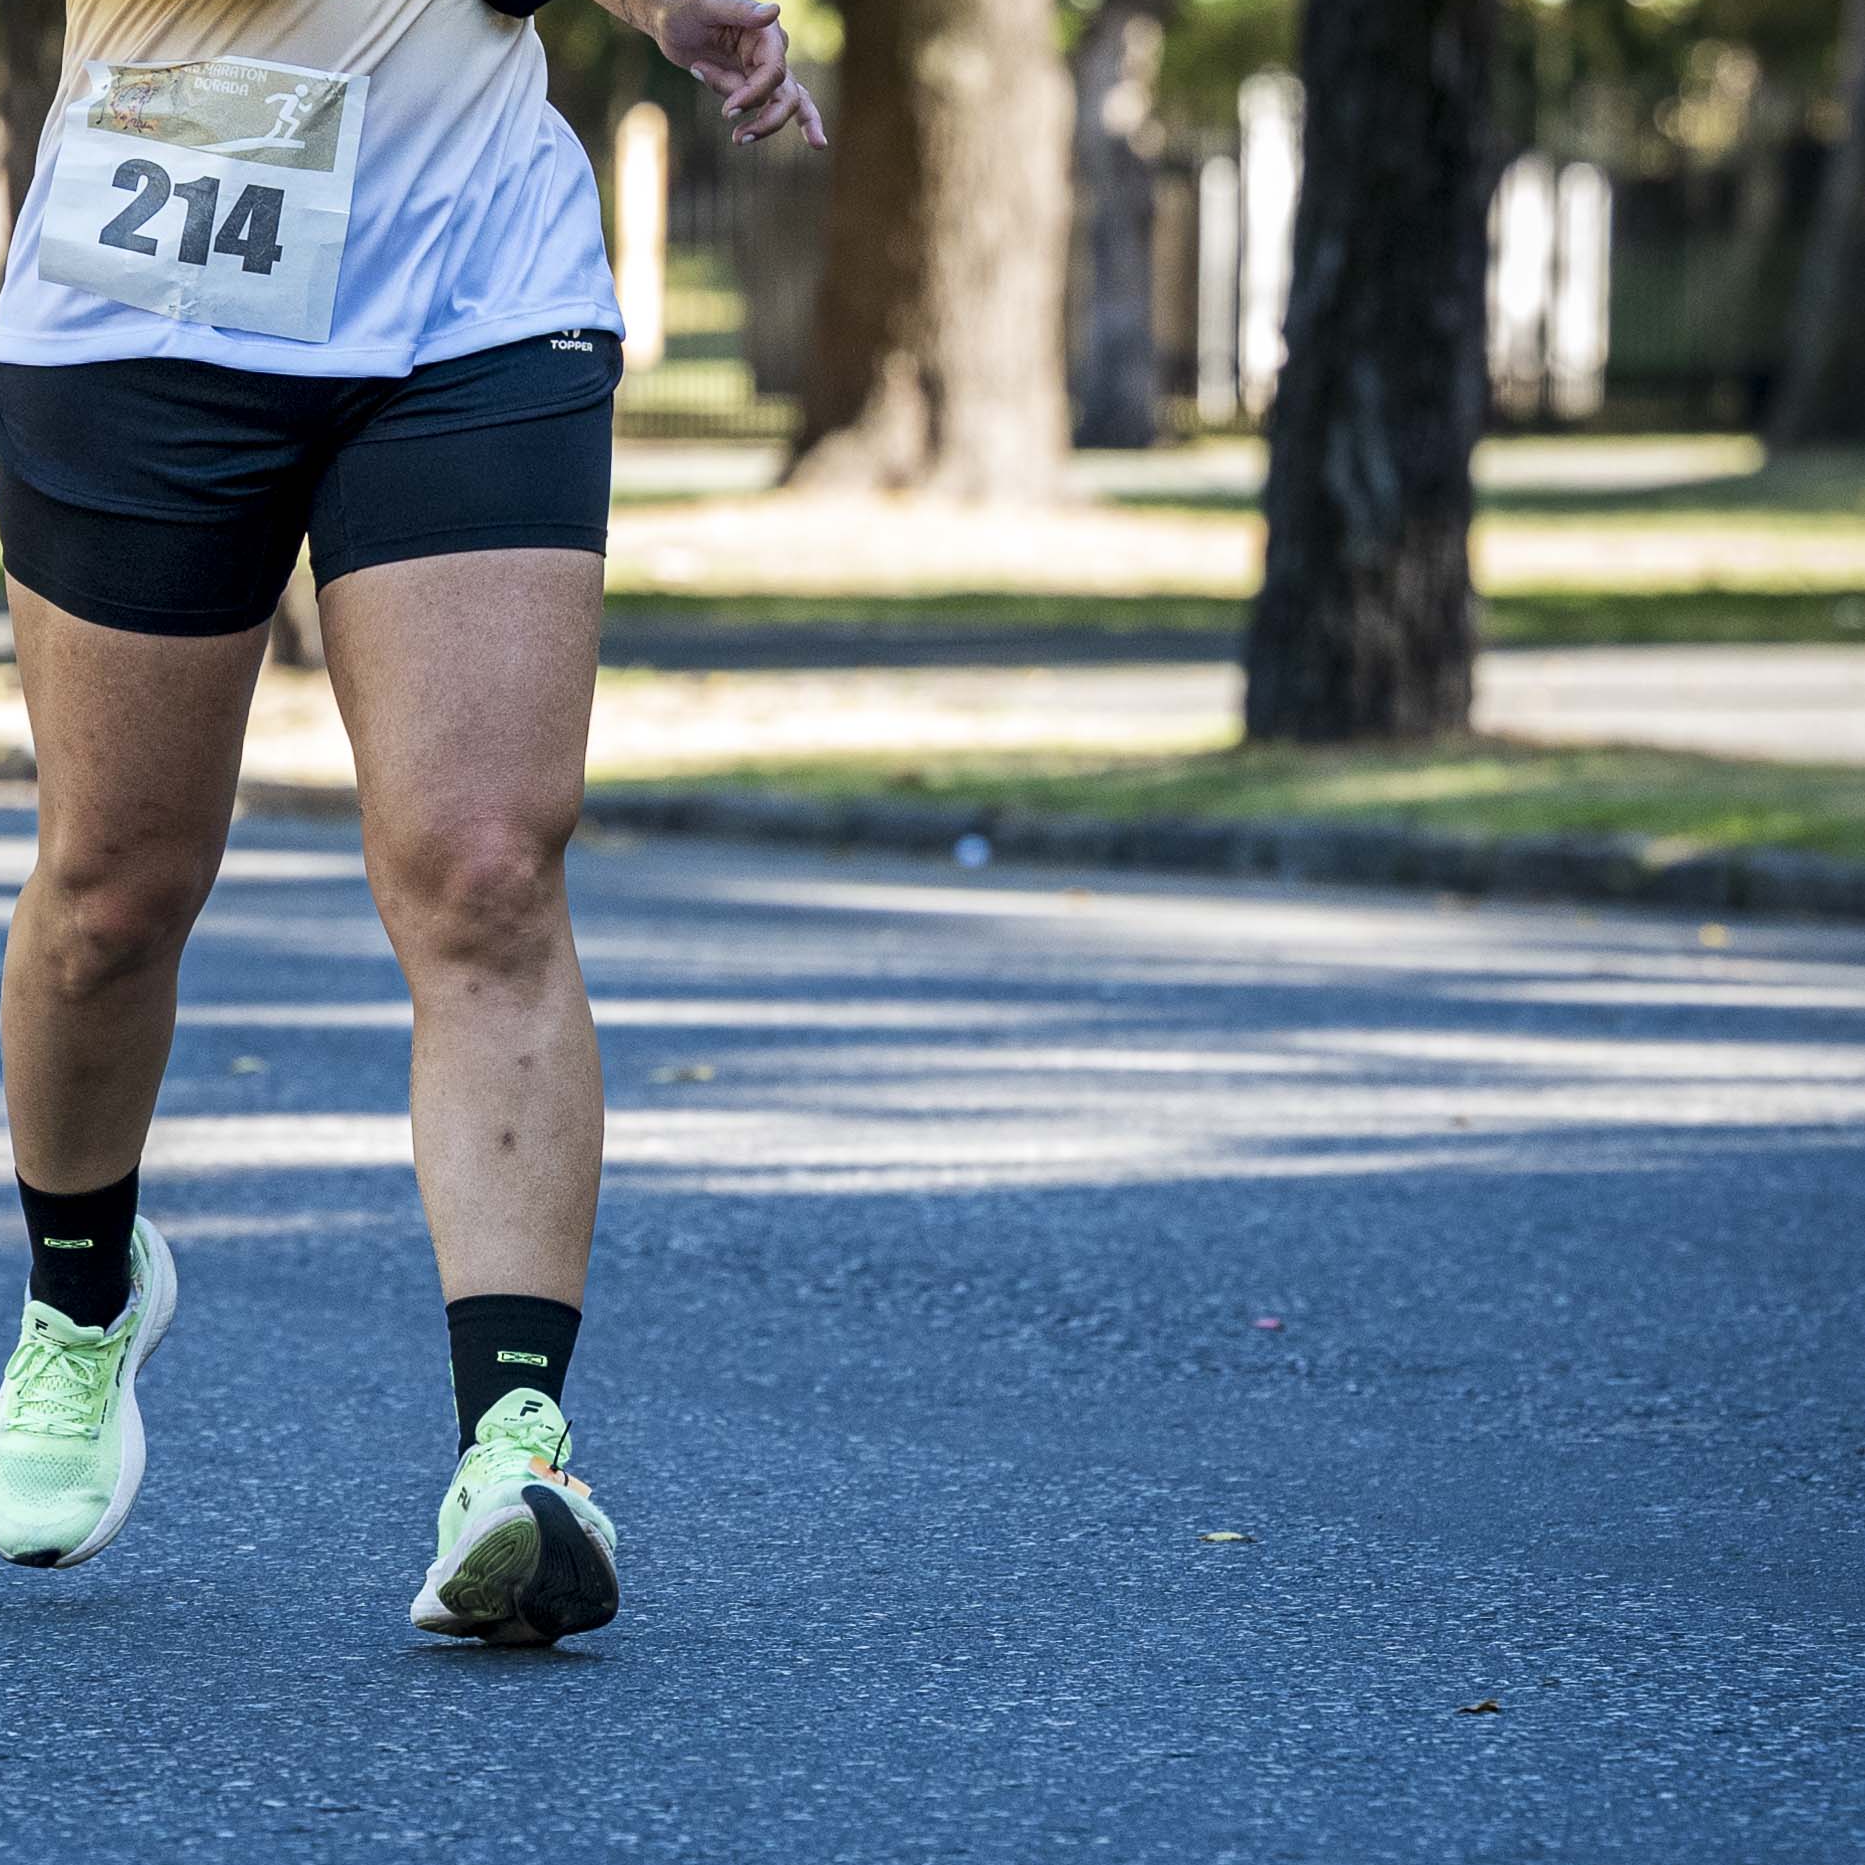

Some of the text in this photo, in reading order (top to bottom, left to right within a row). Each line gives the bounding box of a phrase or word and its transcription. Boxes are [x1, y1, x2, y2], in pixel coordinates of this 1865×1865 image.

[194, 77, 249, 96] DORADA
[98, 158, 285, 275] 214
[550, 339, 593, 352] TOPPER
